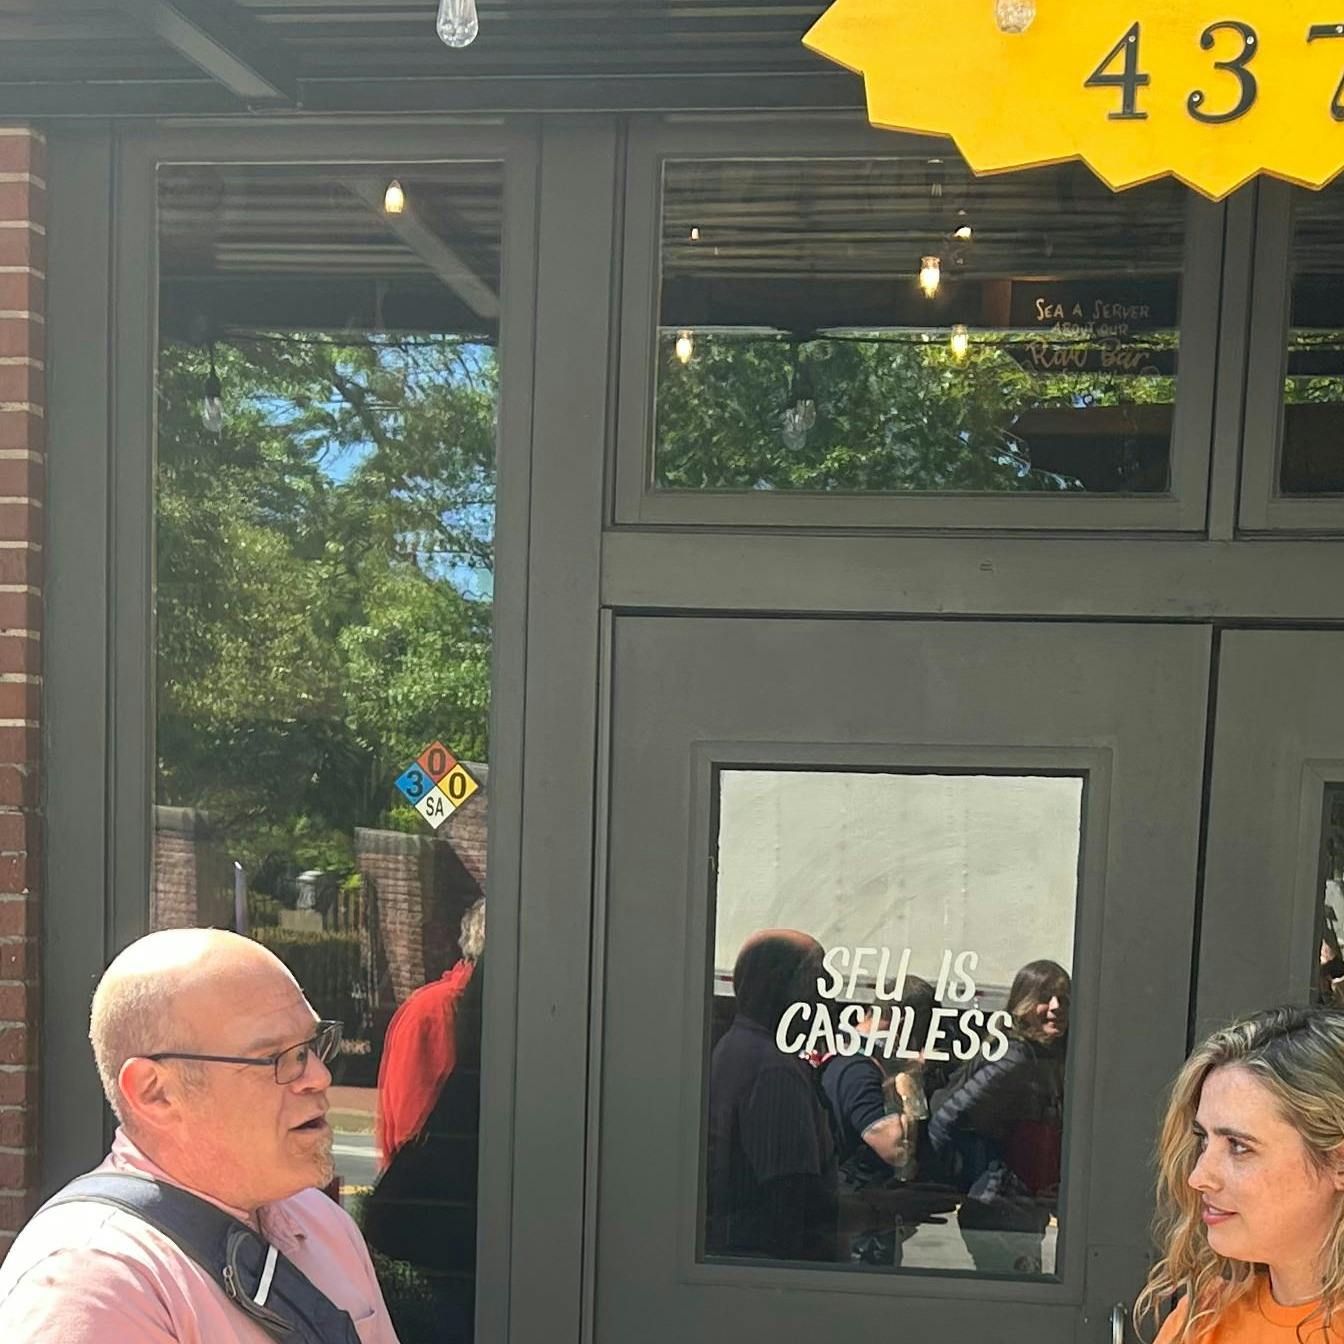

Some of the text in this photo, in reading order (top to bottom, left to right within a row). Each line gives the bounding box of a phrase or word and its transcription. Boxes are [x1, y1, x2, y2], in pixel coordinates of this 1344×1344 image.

[1072, 304, 1083, 318] A
[406, 770, 423, 798] 3
[449, 772, 466, 800] 0
[425, 797, 445, 817] SA
[816, 946, 978, 1002] SFU IS
[775, 1002, 1015, 1062] CASHLESS
